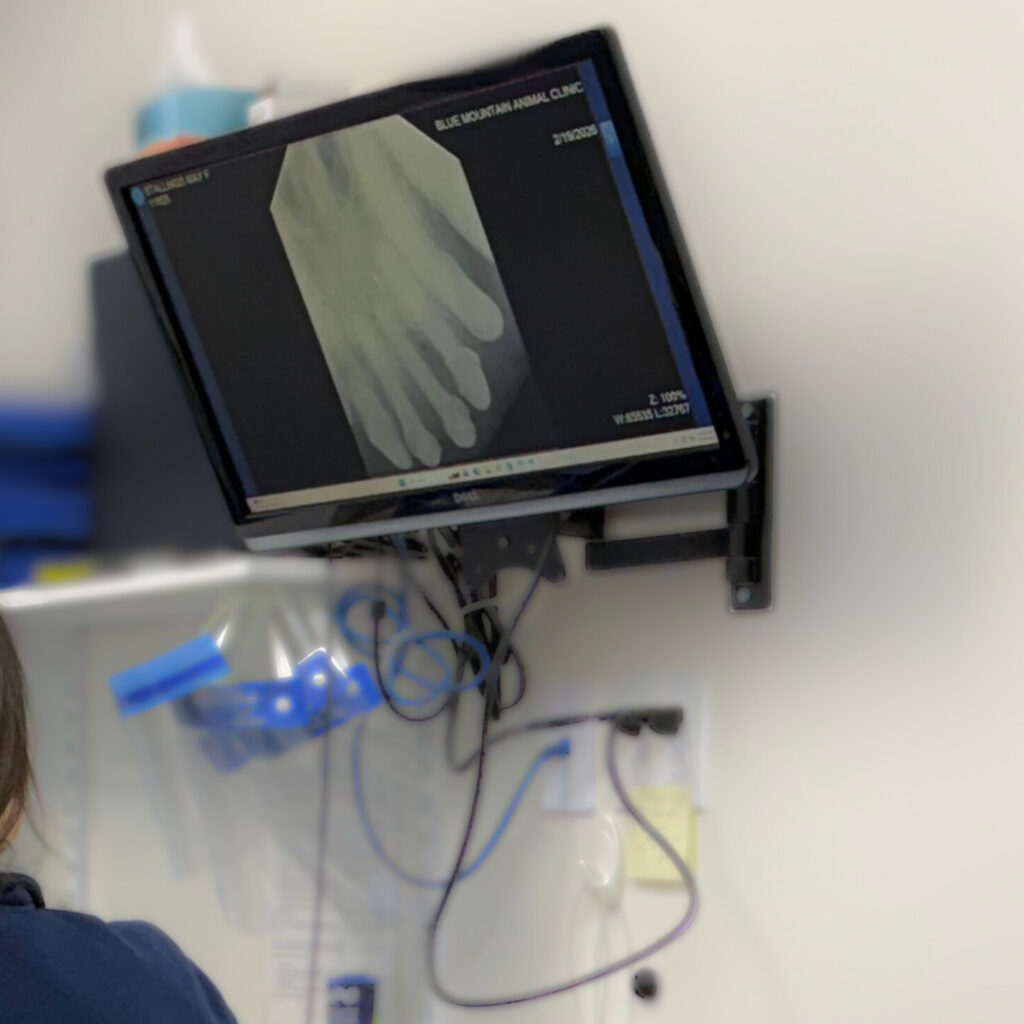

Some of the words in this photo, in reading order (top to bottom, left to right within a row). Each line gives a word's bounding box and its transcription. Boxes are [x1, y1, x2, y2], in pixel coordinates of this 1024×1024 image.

[434, 114, 462, 132] BLUE
[461, 101, 513, 124] MOUNTAIN
[513, 91, 550, 111] ANIMAL
[549, 80, 584, 101] CLINIC
